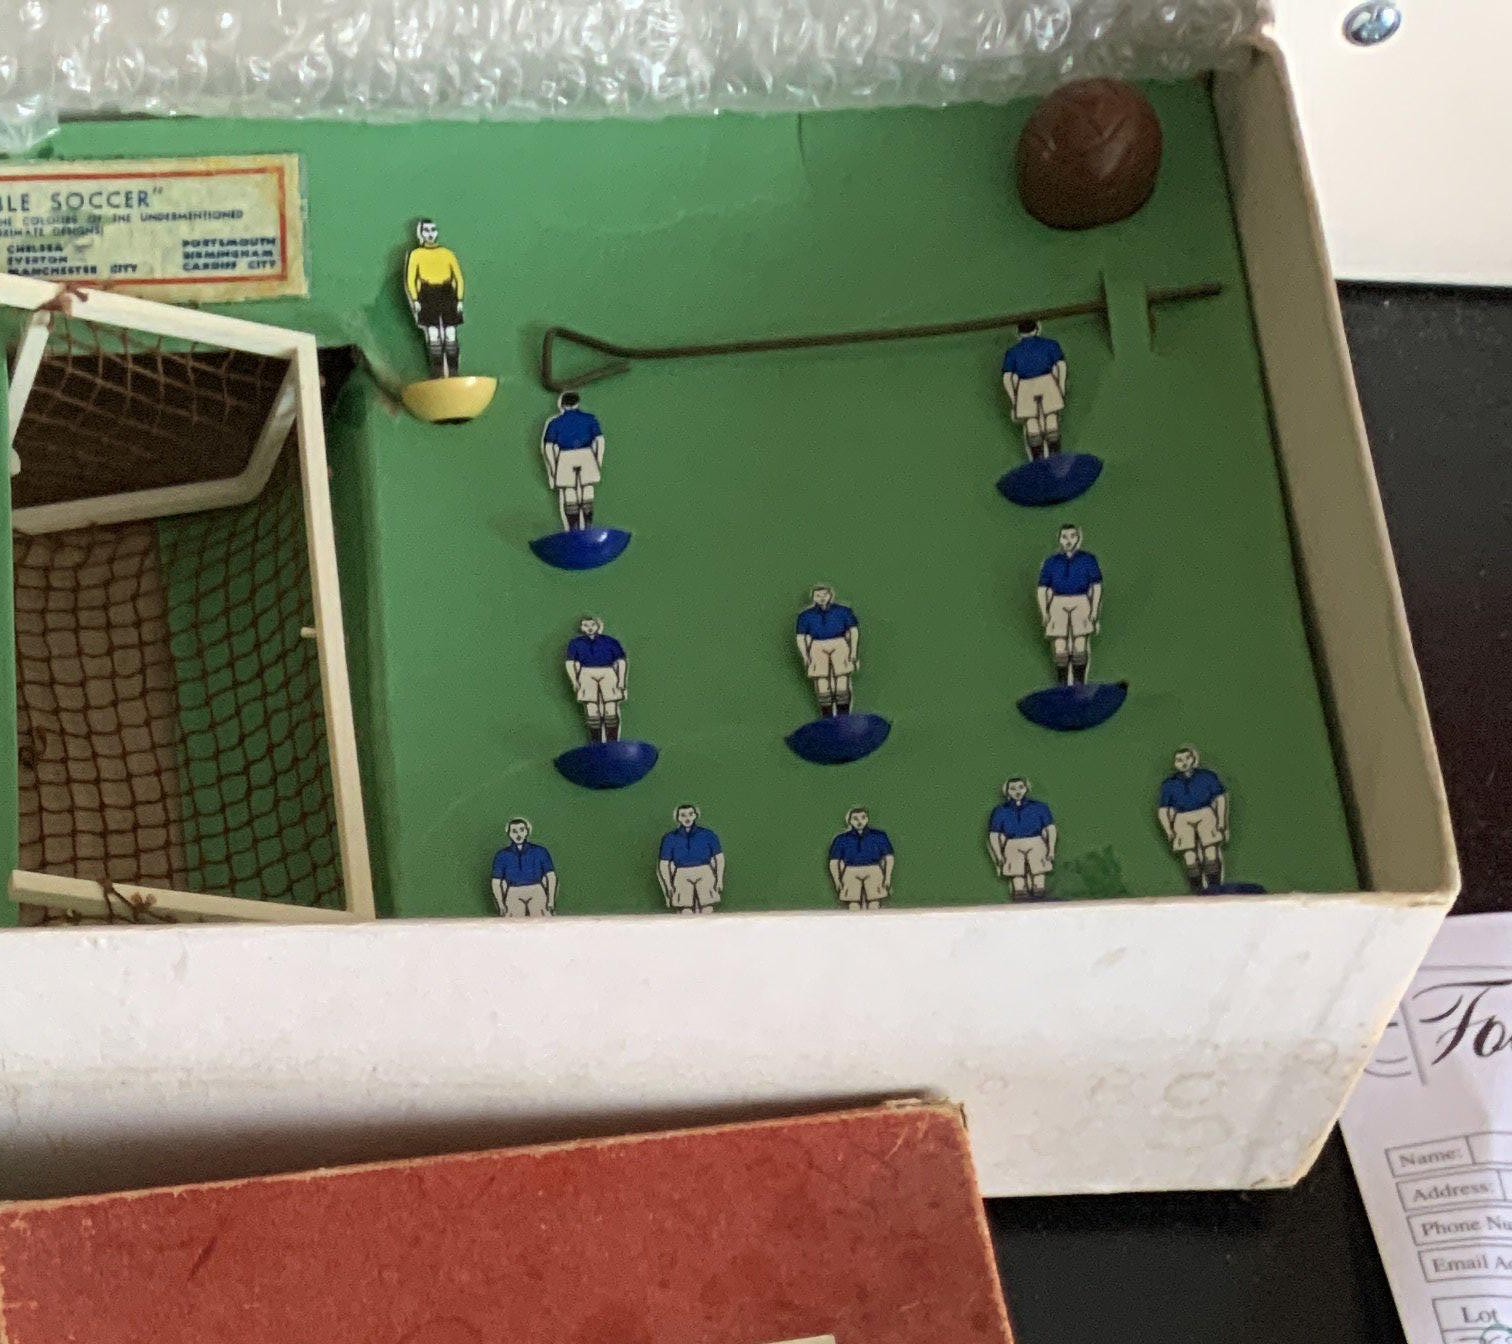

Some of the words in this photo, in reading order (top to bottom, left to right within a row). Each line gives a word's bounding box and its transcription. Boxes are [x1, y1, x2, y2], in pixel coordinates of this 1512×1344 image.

[1399, 1149, 1462, 1168] Name:
[1422, 1216, 1481, 1237] Phone
[1431, 1254, 1489, 1274] Email
[1461, 1306, 1498, 1323] Lot
